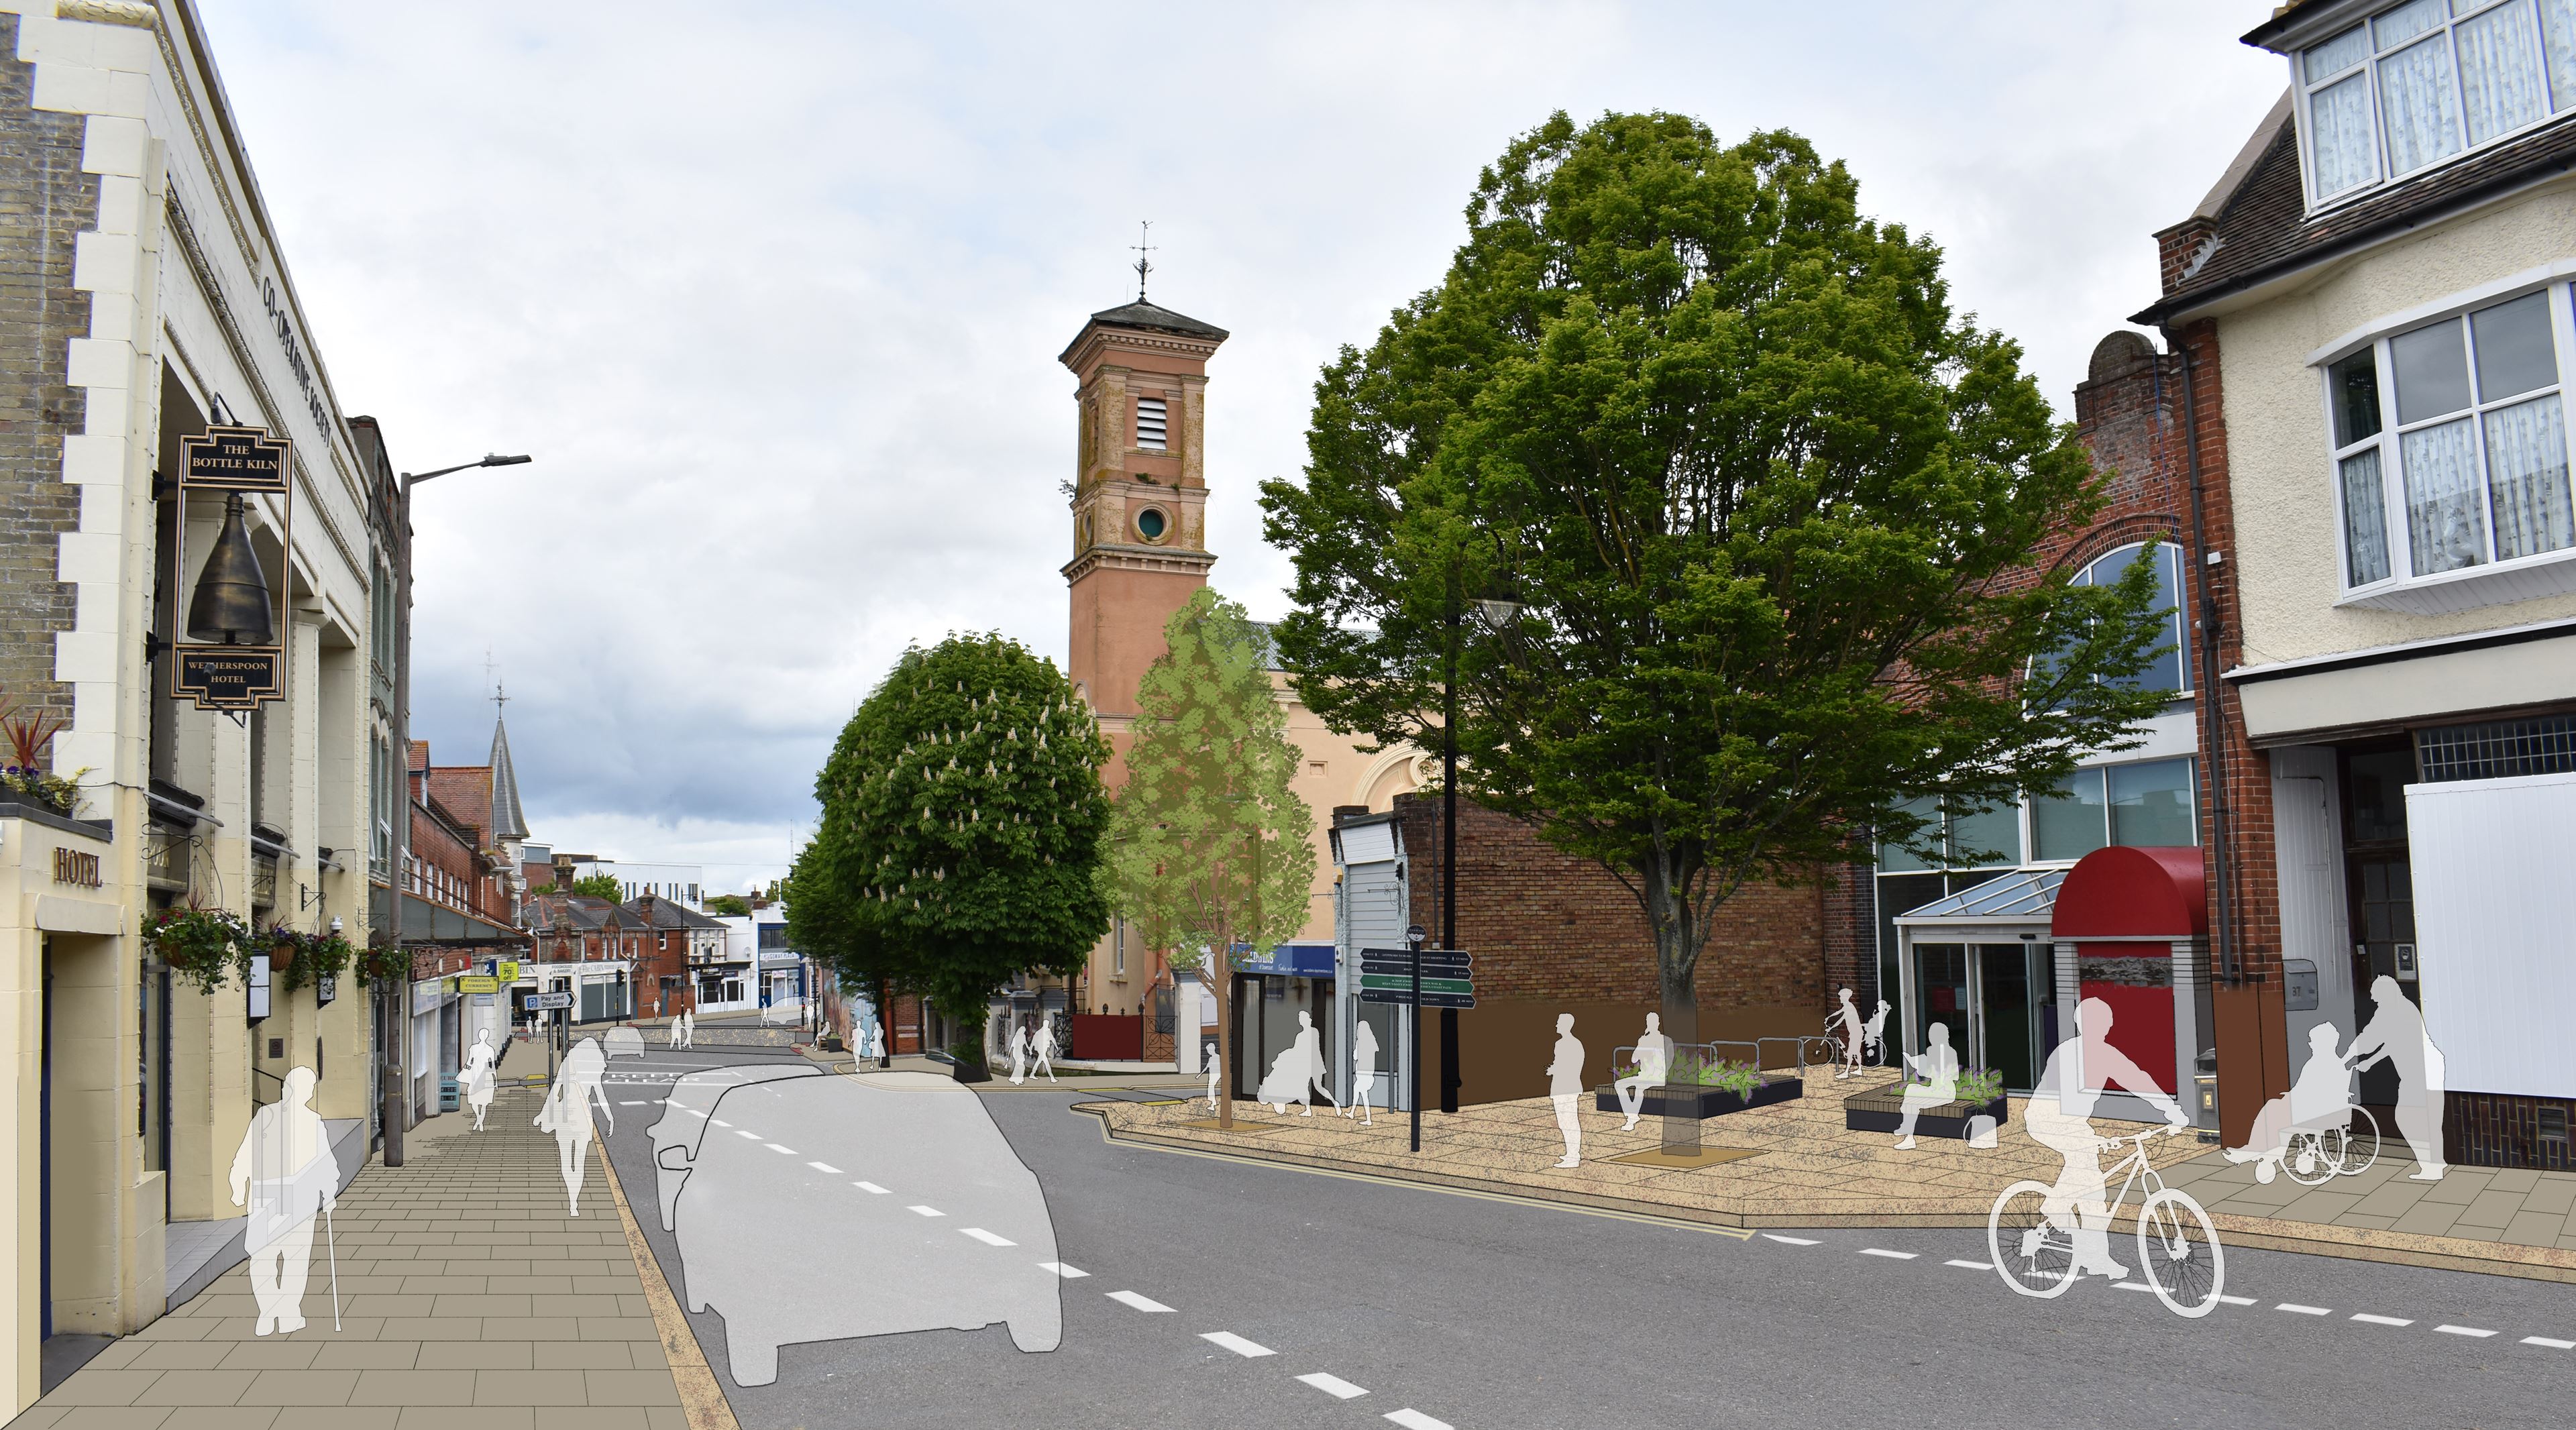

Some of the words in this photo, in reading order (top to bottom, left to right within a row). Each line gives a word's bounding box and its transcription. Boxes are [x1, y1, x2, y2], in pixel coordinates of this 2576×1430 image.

[263, 276, 310, 402] CO-OPERATIVE
[309, 386, 331, 448] SOCIETY
[223, 444, 250, 454] THE
[193, 457, 243, 468] BOTTLE
[247, 459, 278, 470] KILN
[211, 675, 246, 683] HOTEL
[54, 846, 102, 888] HOTEL
[519, 966, 536, 974] BIN
